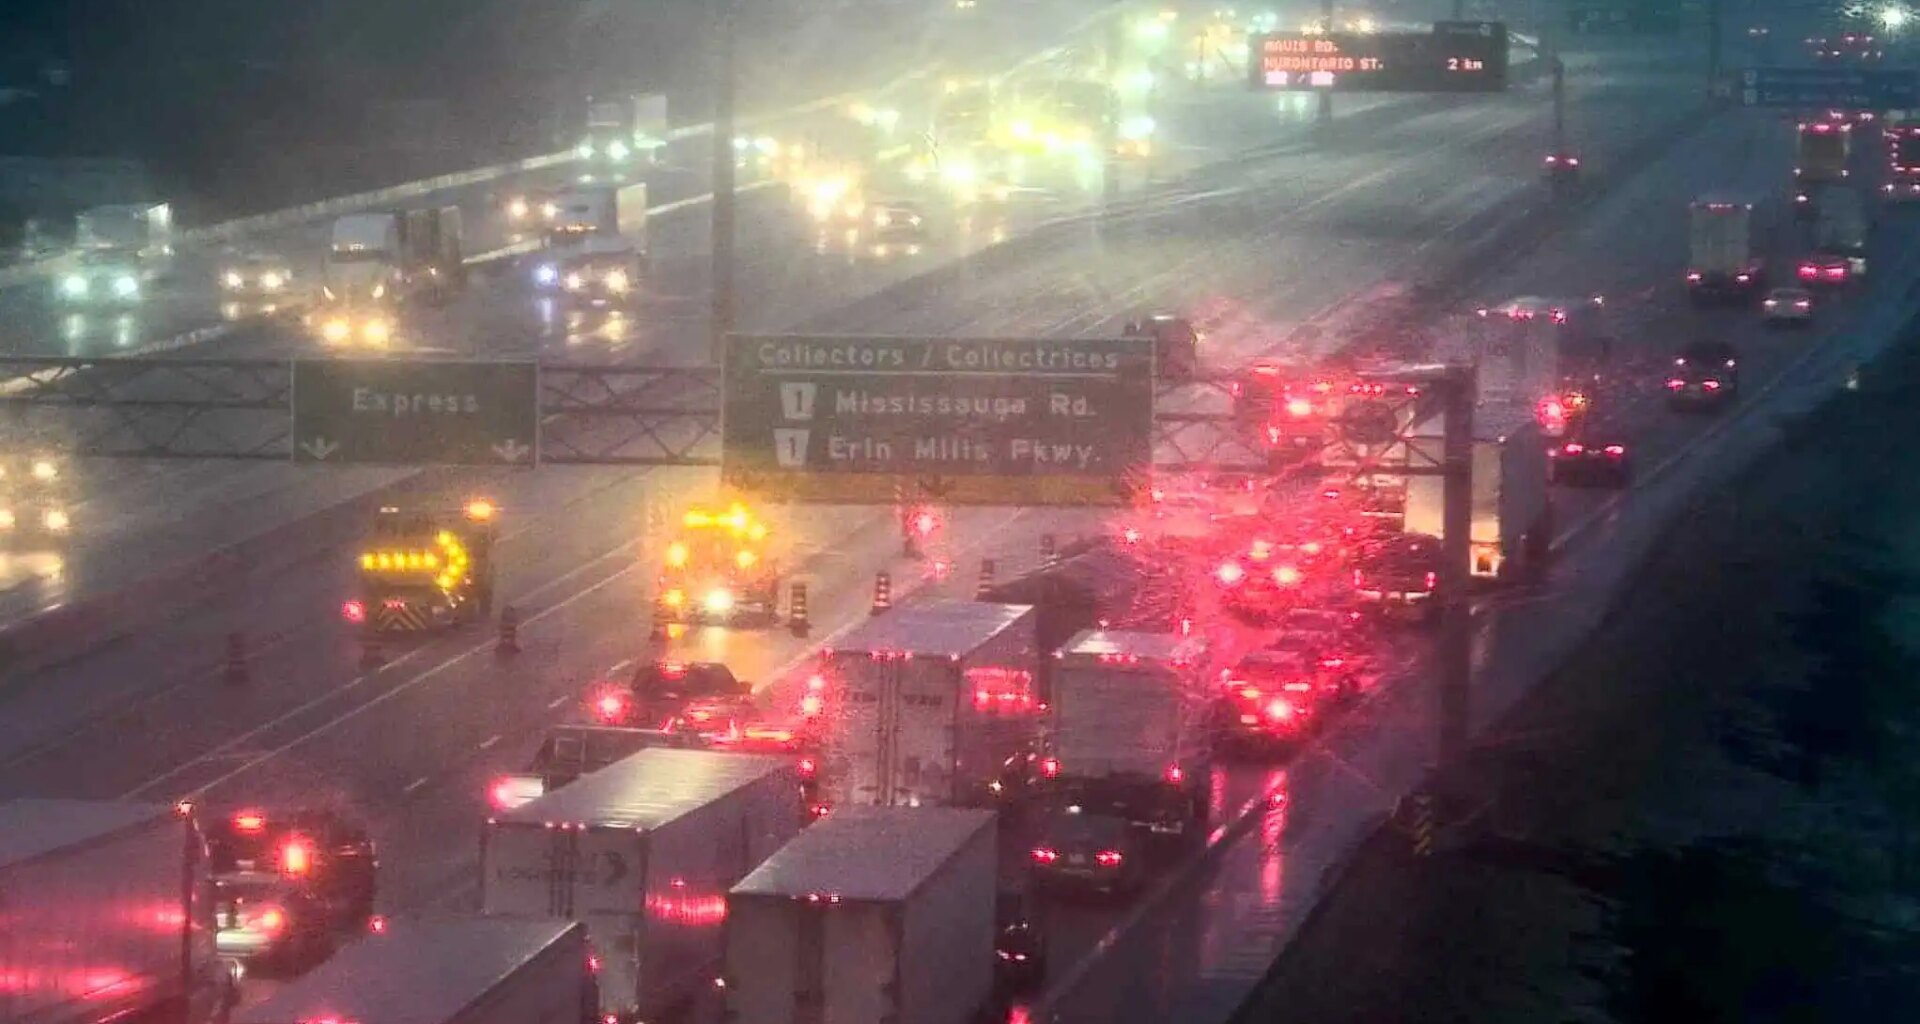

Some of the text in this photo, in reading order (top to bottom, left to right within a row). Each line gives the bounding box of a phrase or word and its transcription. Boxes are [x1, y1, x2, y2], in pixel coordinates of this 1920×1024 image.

[1263, 57, 1483, 70] HURONTARIO ST. 2 km
[757, 342, 905, 366] Collectors
[946, 343, 1118, 369] Collectrices
[353, 387, 479, 416] Express
[835, 389, 1026, 421] Mississauga
[1050, 391, 1098, 417] Rd.
[828, 435, 891, 461] Erin
[914, 437, 988, 462] Mills
[1010, 439, 1102, 469] Pkwy.
